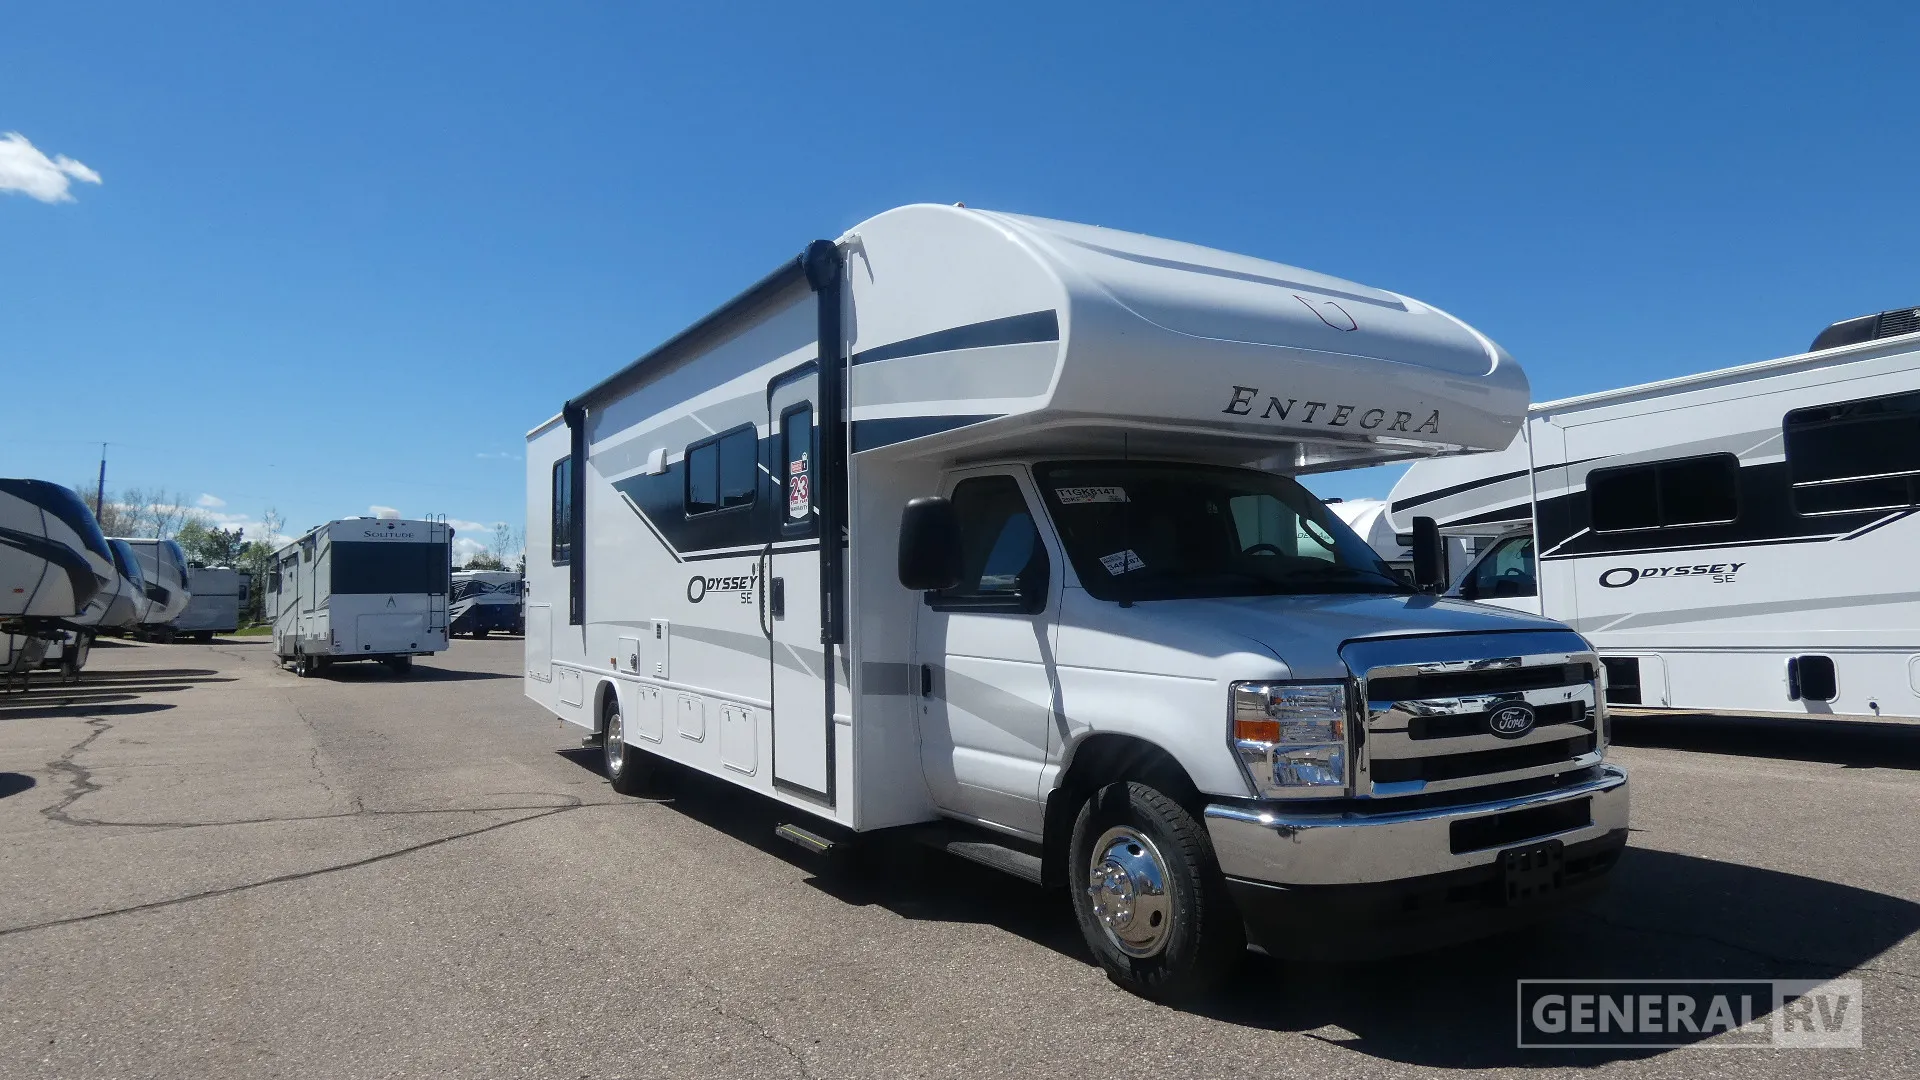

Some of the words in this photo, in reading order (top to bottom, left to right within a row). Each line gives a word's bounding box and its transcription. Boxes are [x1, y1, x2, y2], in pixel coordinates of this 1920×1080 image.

[1222, 385, 1441, 434] ENTEGRA
[364, 530, 415, 538] SOLITUDE
[1598, 562, 1746, 588] ODYSSEY
[1712, 574, 1735, 583] SE
[687, 575, 758, 603] ODYSSEY
[740, 592, 752, 604] SE
[1499, 711, 1526, 730] Ford
